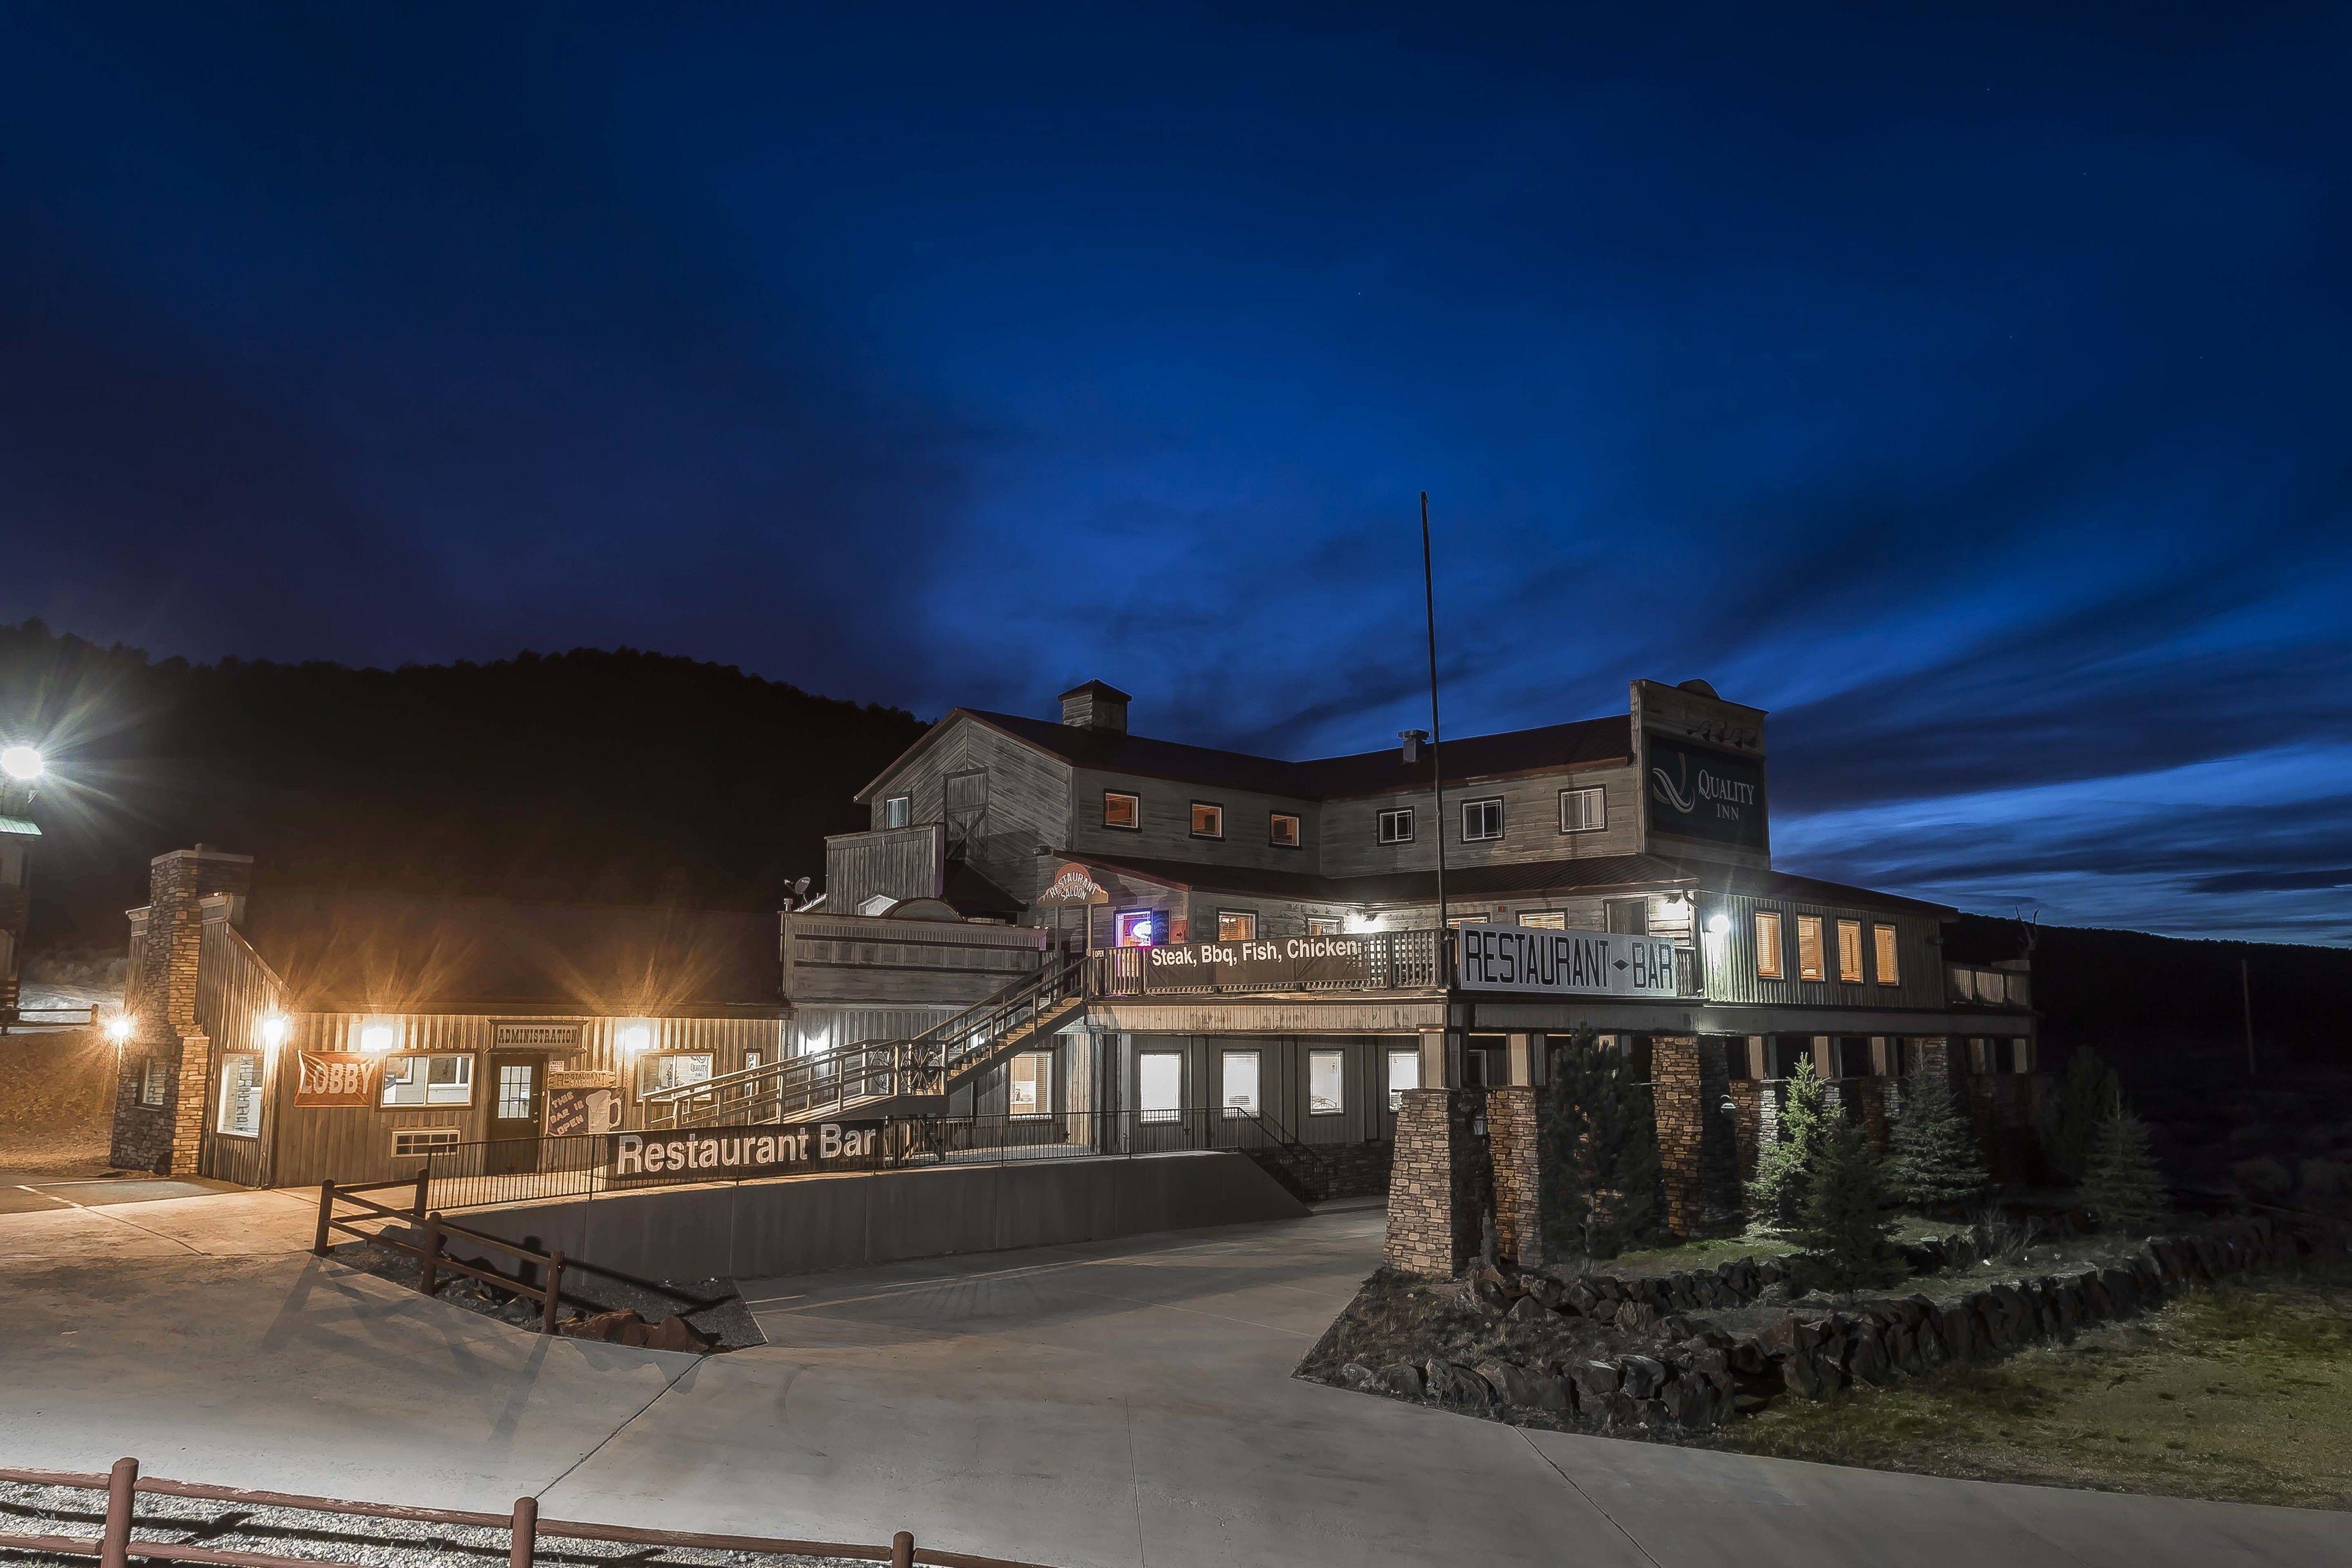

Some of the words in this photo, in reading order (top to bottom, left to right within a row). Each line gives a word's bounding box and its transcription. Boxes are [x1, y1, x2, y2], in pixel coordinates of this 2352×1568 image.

[1698, 770, 1754, 805] QUALITY
[1717, 804, 1739, 821] INN
[1049, 872, 1098, 899] RESTAURANT
[1061, 885, 1087, 901] SALOON
[1152, 948, 1197, 967] Steak,
[1202, 945, 1237, 966] Bbq,
[1243, 941, 1282, 963] Fish,
[1287, 938, 1357, 959] Chicken
[1464, 929, 1609, 987] RESTAURANT
[1632, 941, 1673, 989] BAR
[498, 1028, 578, 1044] ADMINISTRATION
[300, 1063, 375, 1094] LOBBY
[557, 1073, 606, 1086] RESTAURANT
[552, 1091, 574, 1108] THIS
[574, 1101, 584, 1110] IS
[557, 1115, 584, 1135] OPEN
[617, 1128, 809, 1174] Restaurant
[820, 1124, 875, 1159] Bar
